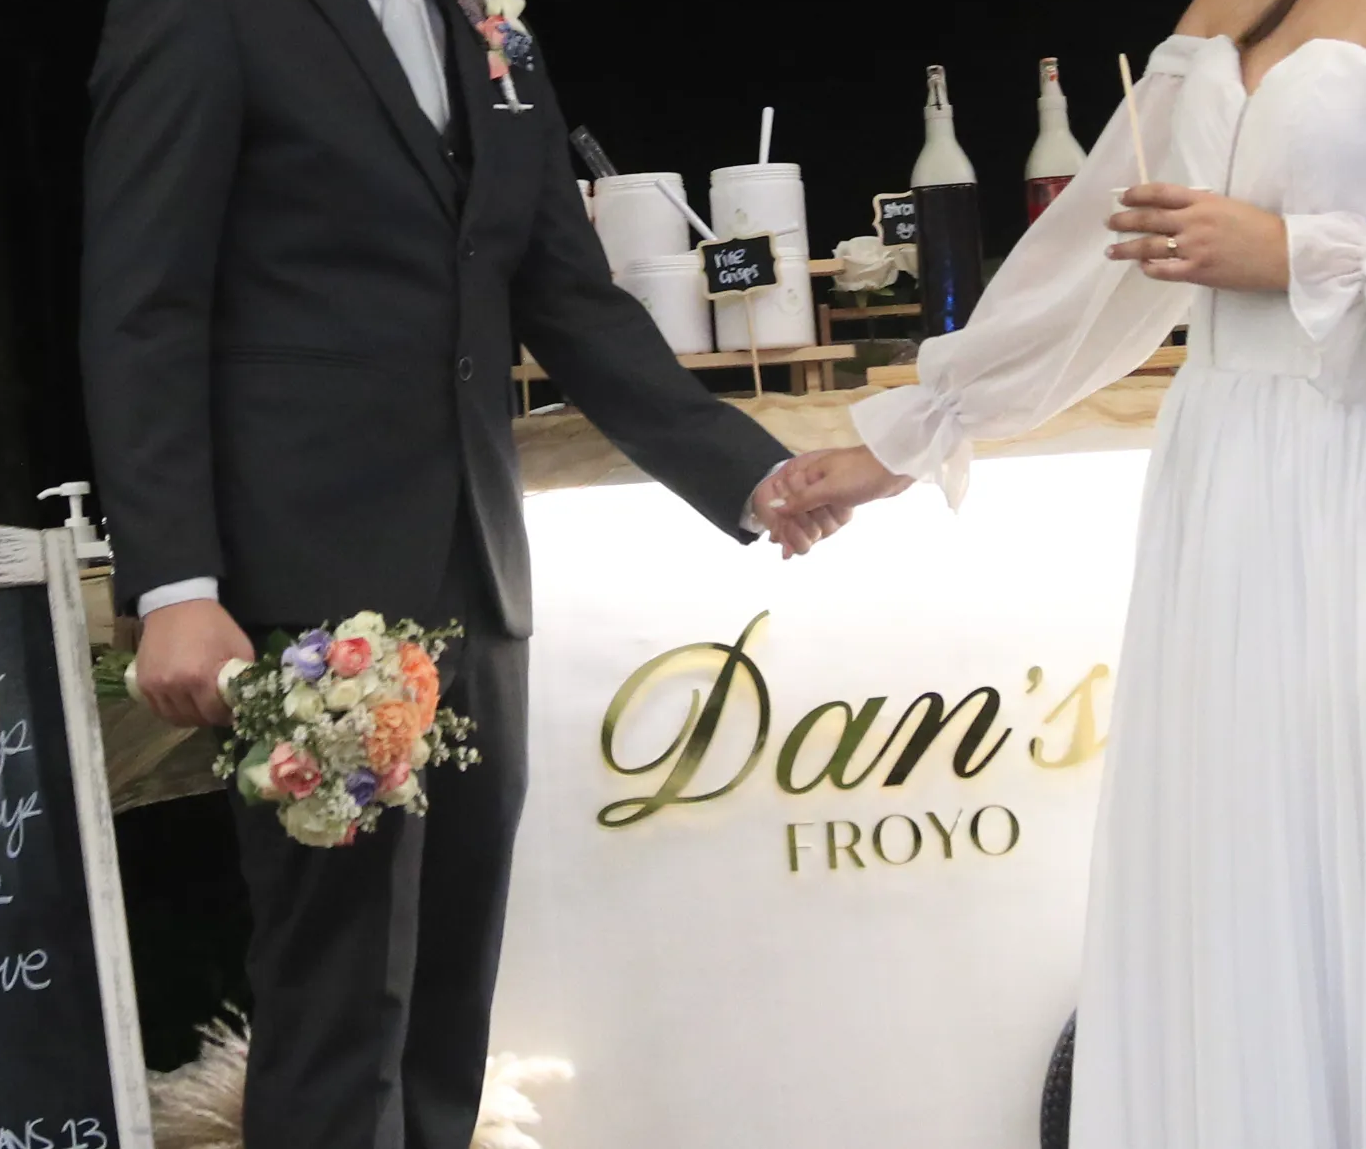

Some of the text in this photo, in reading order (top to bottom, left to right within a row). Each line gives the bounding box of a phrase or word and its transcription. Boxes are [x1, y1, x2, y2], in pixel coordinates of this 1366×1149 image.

[597, 609, 1110, 829] Dan's
[786, 805, 1020, 872] FROYO
[61, 1117, 108, 1149] 13
